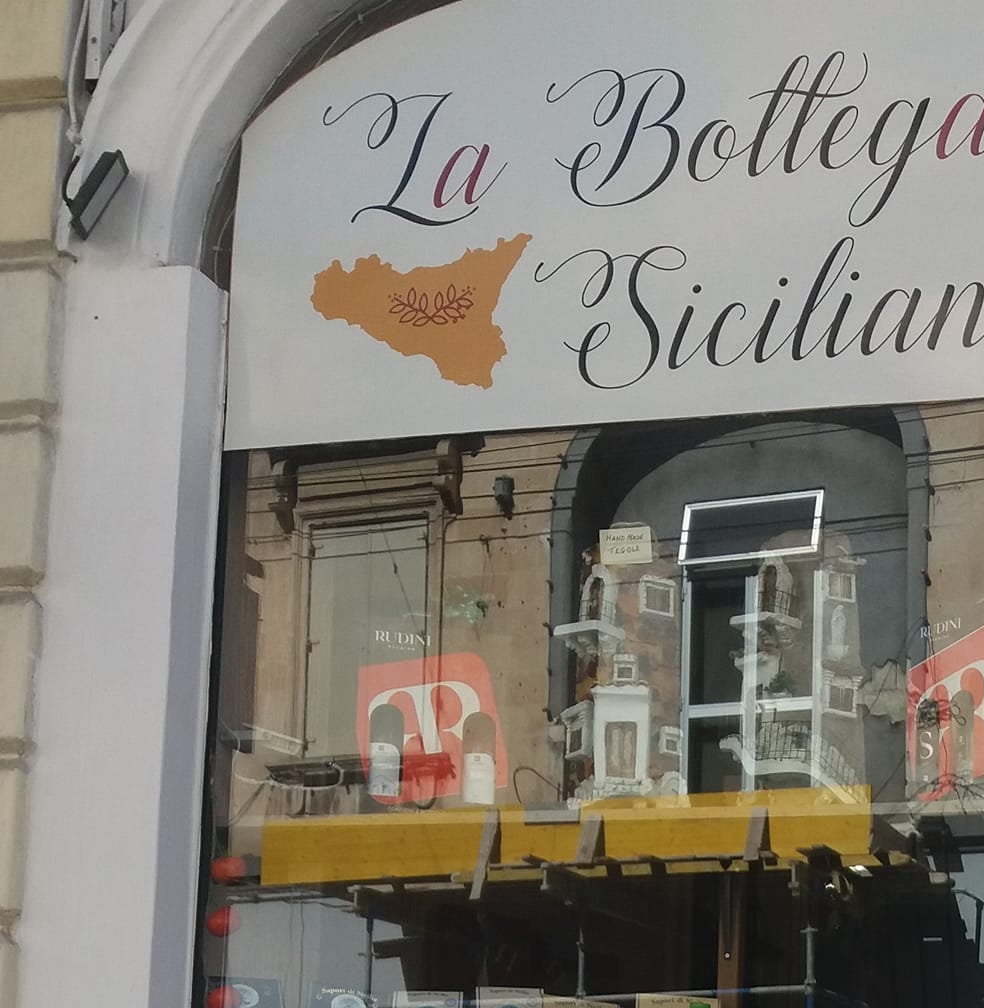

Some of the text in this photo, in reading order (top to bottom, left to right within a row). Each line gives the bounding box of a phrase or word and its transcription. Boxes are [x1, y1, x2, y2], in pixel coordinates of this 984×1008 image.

[323, 91, 507, 226] La
[920, 617, 961, 638] RUDINI
[375, 630, 431, 647] RUDINI
